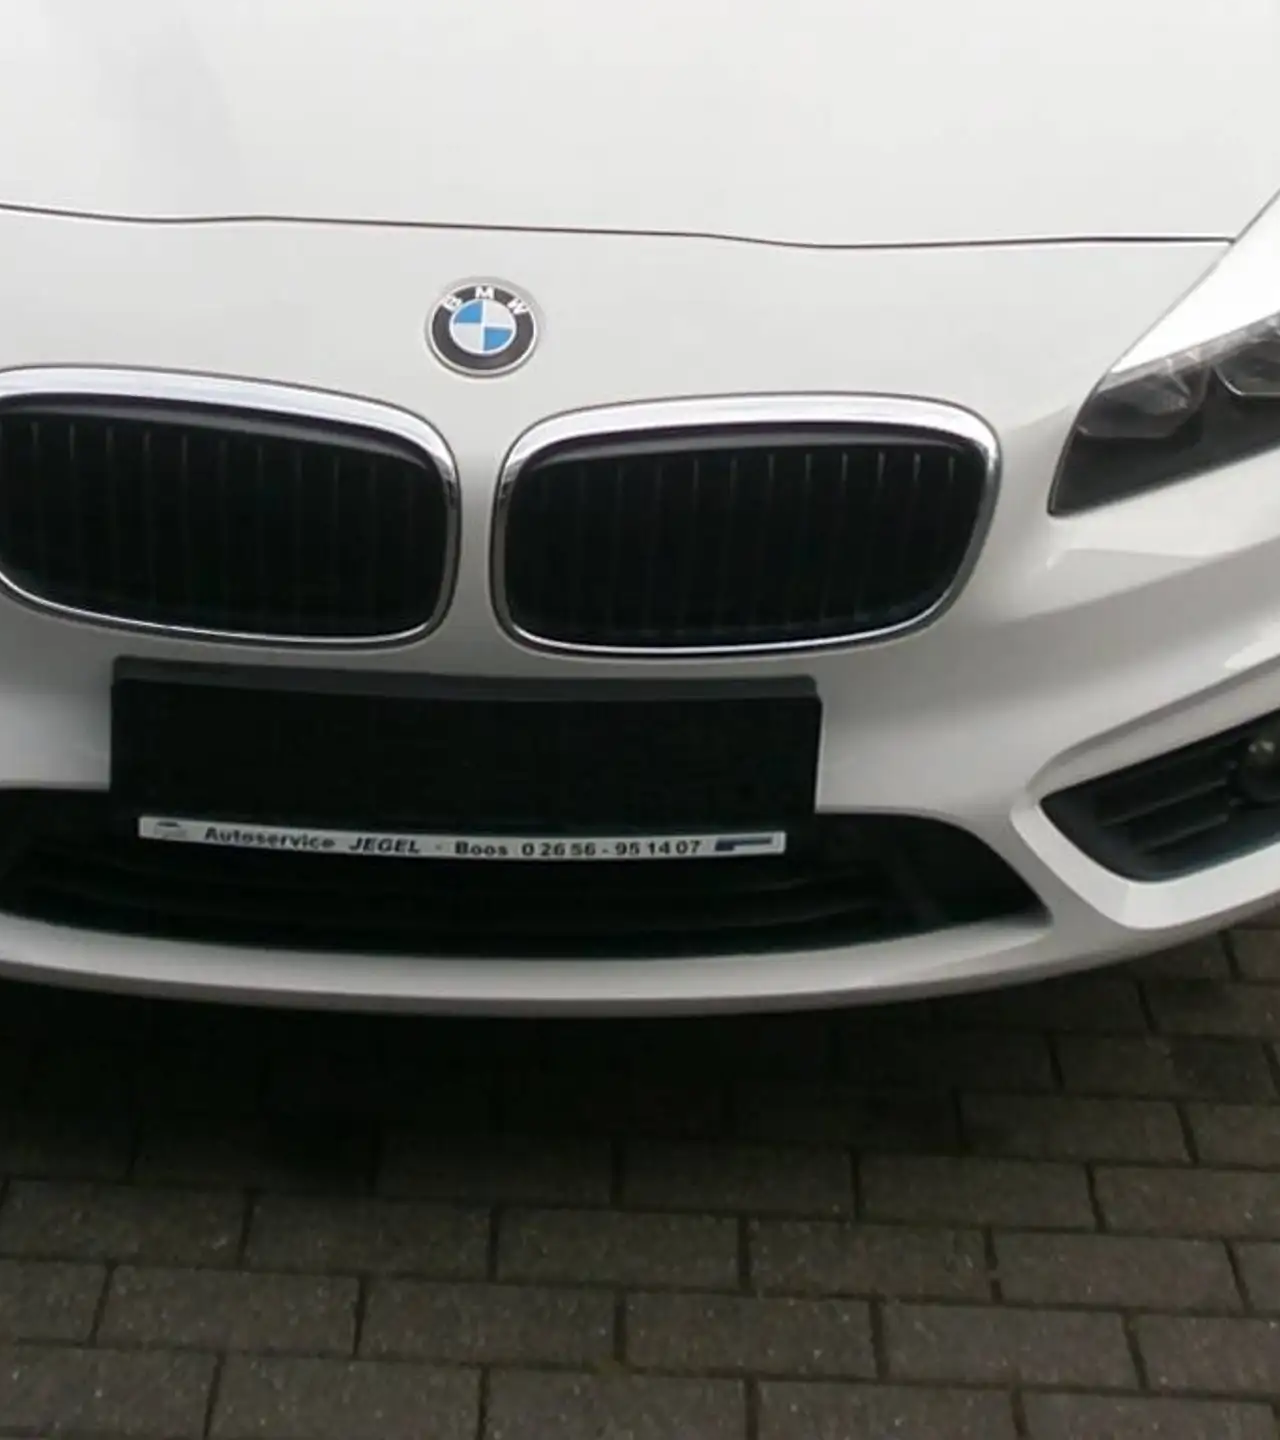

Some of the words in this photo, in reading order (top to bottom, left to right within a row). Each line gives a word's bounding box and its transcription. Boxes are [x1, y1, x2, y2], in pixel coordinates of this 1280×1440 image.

[442, 285, 530, 315] BMW
[205, 826, 335, 850] Autoservice
[348, 836, 420, 854] JEGEL
[454, 840, 508, 856] Boos
